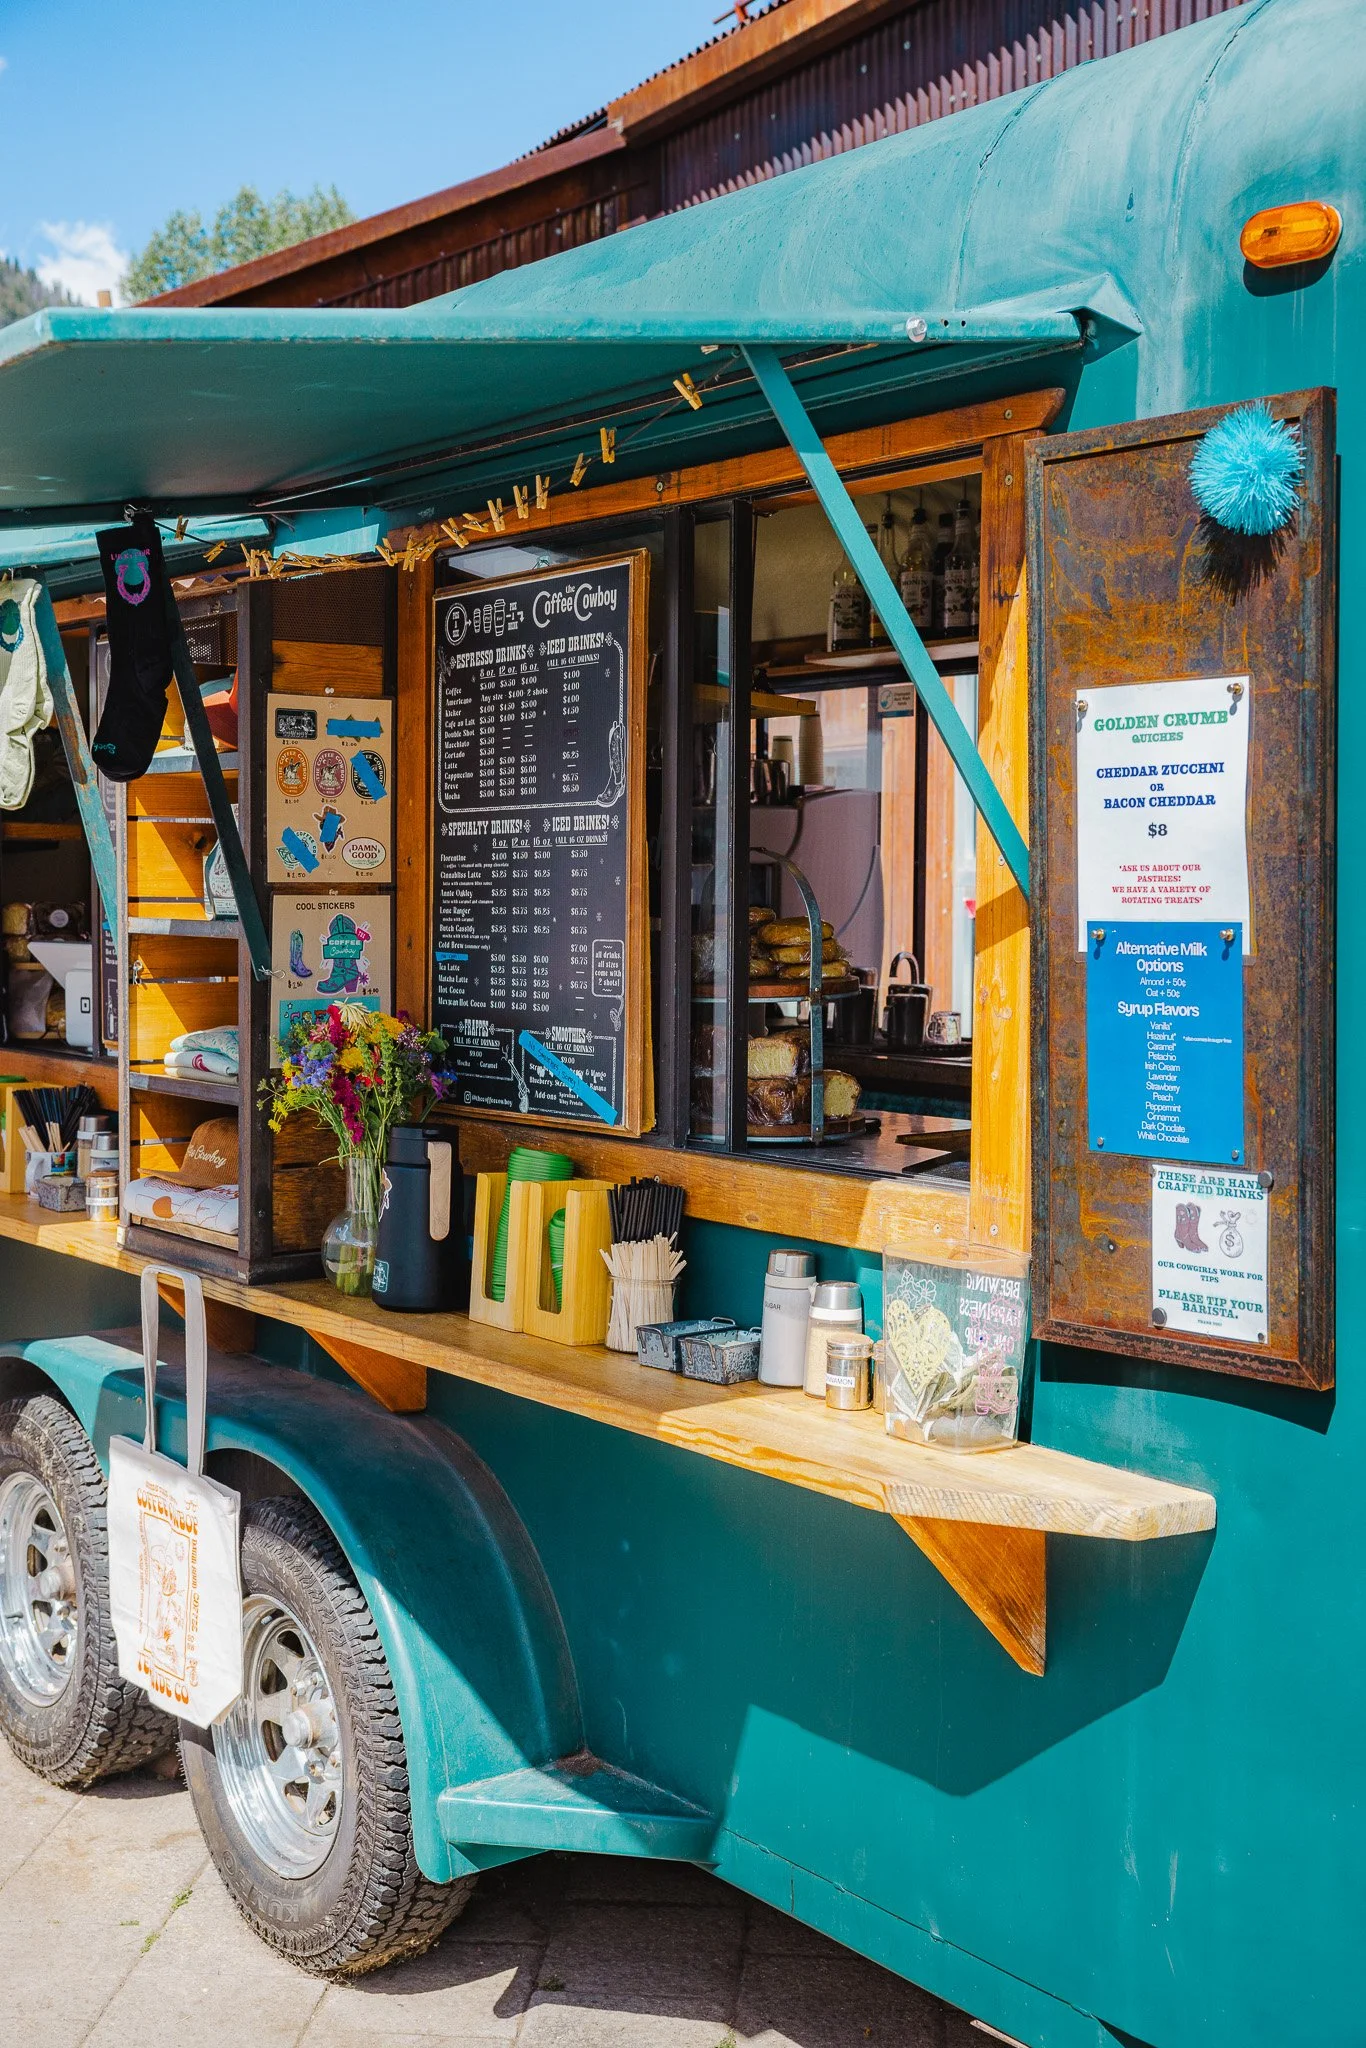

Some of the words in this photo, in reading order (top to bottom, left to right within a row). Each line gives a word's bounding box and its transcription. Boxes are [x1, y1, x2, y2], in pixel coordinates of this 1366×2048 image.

[565, 584, 576, 594] the
[532, 590, 572, 628] Coffee
[574, 583, 617, 621] Cowboy
[547, 638, 566, 655] ICED
[568, 632, 604, 652] DRINKS!
[456, 651, 493, 669] ESPRESSO
[496, 644, 526, 663] DRINKS
[520, 662, 528, 672] 16
[446, 688, 462, 696] Coffee
[446, 697, 472, 706] Americano
[1094, 715, 1159, 732] GOLDEN
[1164, 710, 1228, 727] CRUMB
[445, 730, 461, 738] Double
[1132, 732, 1183, 743] QUICHES
[445, 740, 470, 749] Macchiato
[1096, 765, 1158, 778] CHEDDAR
[1162, 762, 1224, 776] ZUCCHNI
[445, 772, 473, 781] Cappuccino
[562, 773, 578, 782] $6.75
[1104, 797, 1145, 809] BACON
[1149, 795, 1216, 807] CHEDDAR
[448, 821, 488, 836] SPECIALTY
[491, 819, 522, 834] DRINKS!
[552, 816, 570, 832] ICED
[574, 815, 610, 830] DRINKS!
[1148, 822, 1168, 838] $8
[533, 837, 540, 846] 16
[571, 869, 588, 877] $6.75
[456, 889, 473, 898] Oakley
[571, 888, 588, 897] $6.75
[453, 907, 470, 917] Ranger
[571, 907, 588, 916] $6.75
[456, 924, 475, 934] Cassidy
[571, 926, 587, 934] $6.75
[330, 946, 356, 957] Cowboy
[571, 944, 588, 952] $7.00
[1116, 941, 1178, 956] Alternative
[1180, 942, 1208, 956] Milk
[571, 957, 588, 965] $6.75
[1136, 958, 1183, 973] Options
[570, 981, 588, 990] $6.75
[1140, 977, 1164, 986] Almond
[1173, 978, 1186, 987] 50¢
[1146, 988, 1158, 997] Oat
[1166, 989, 1180, 998] 50¢
[438, 997, 458, 1005] Mexican
[460, 998, 469, 1006] Hot
[470, 1000, 486, 1008] Cocoa
[1118, 1001, 1152, 1017] Syrup
[1155, 1002, 1199, 1017] Flavors
[464, 1019, 489, 1037] FRAPPES
[552, 1026, 586, 1044] SMOOTHIES
[1148, 1052, 1176, 1061] Pistachio
[480, 1061, 498, 1069] Caramel
[1145, 1062, 1157, 1071] Irish
[1158, 1063, 1180, 1072] Cream
[1148, 1072, 1177, 1081] Lavender
[1146, 1082, 1180, 1094] Strawberry
[1153, 1092, 1173, 1101] Peach
[1146, 1102, 1181, 1114] Peppermint
[1147, 1112, 1179, 1122] Cinnamon
[1141, 1122, 1157, 1131] Dark
[1138, 1131, 1156, 1140] White
[1157, 1132, 1190, 1144] Chocolate
[195, 1145, 227, 1168] Cowboy
[1158, 1171, 1197, 1183] THESE
[1200, 1176, 1225, 1186] ARE
[1158, 1181, 1213, 1195] CRAFTED
[1216, 1188, 1264, 1200] DRINKS
[1176, 1263, 1217, 1275] COWGIRLS
[1219, 1269, 1244, 1279] WORK
[1247, 1273, 1263, 1281] FOR
[1158, 1289, 1203, 1303] PLEASE
[1206, 1297, 1226, 1307] TIP
[1231, 1300, 1263, 1313] YOUR
[1182, 1303, 1238, 1319] BARISTA.
[191, 1593, 199, 1633] COFFEE
